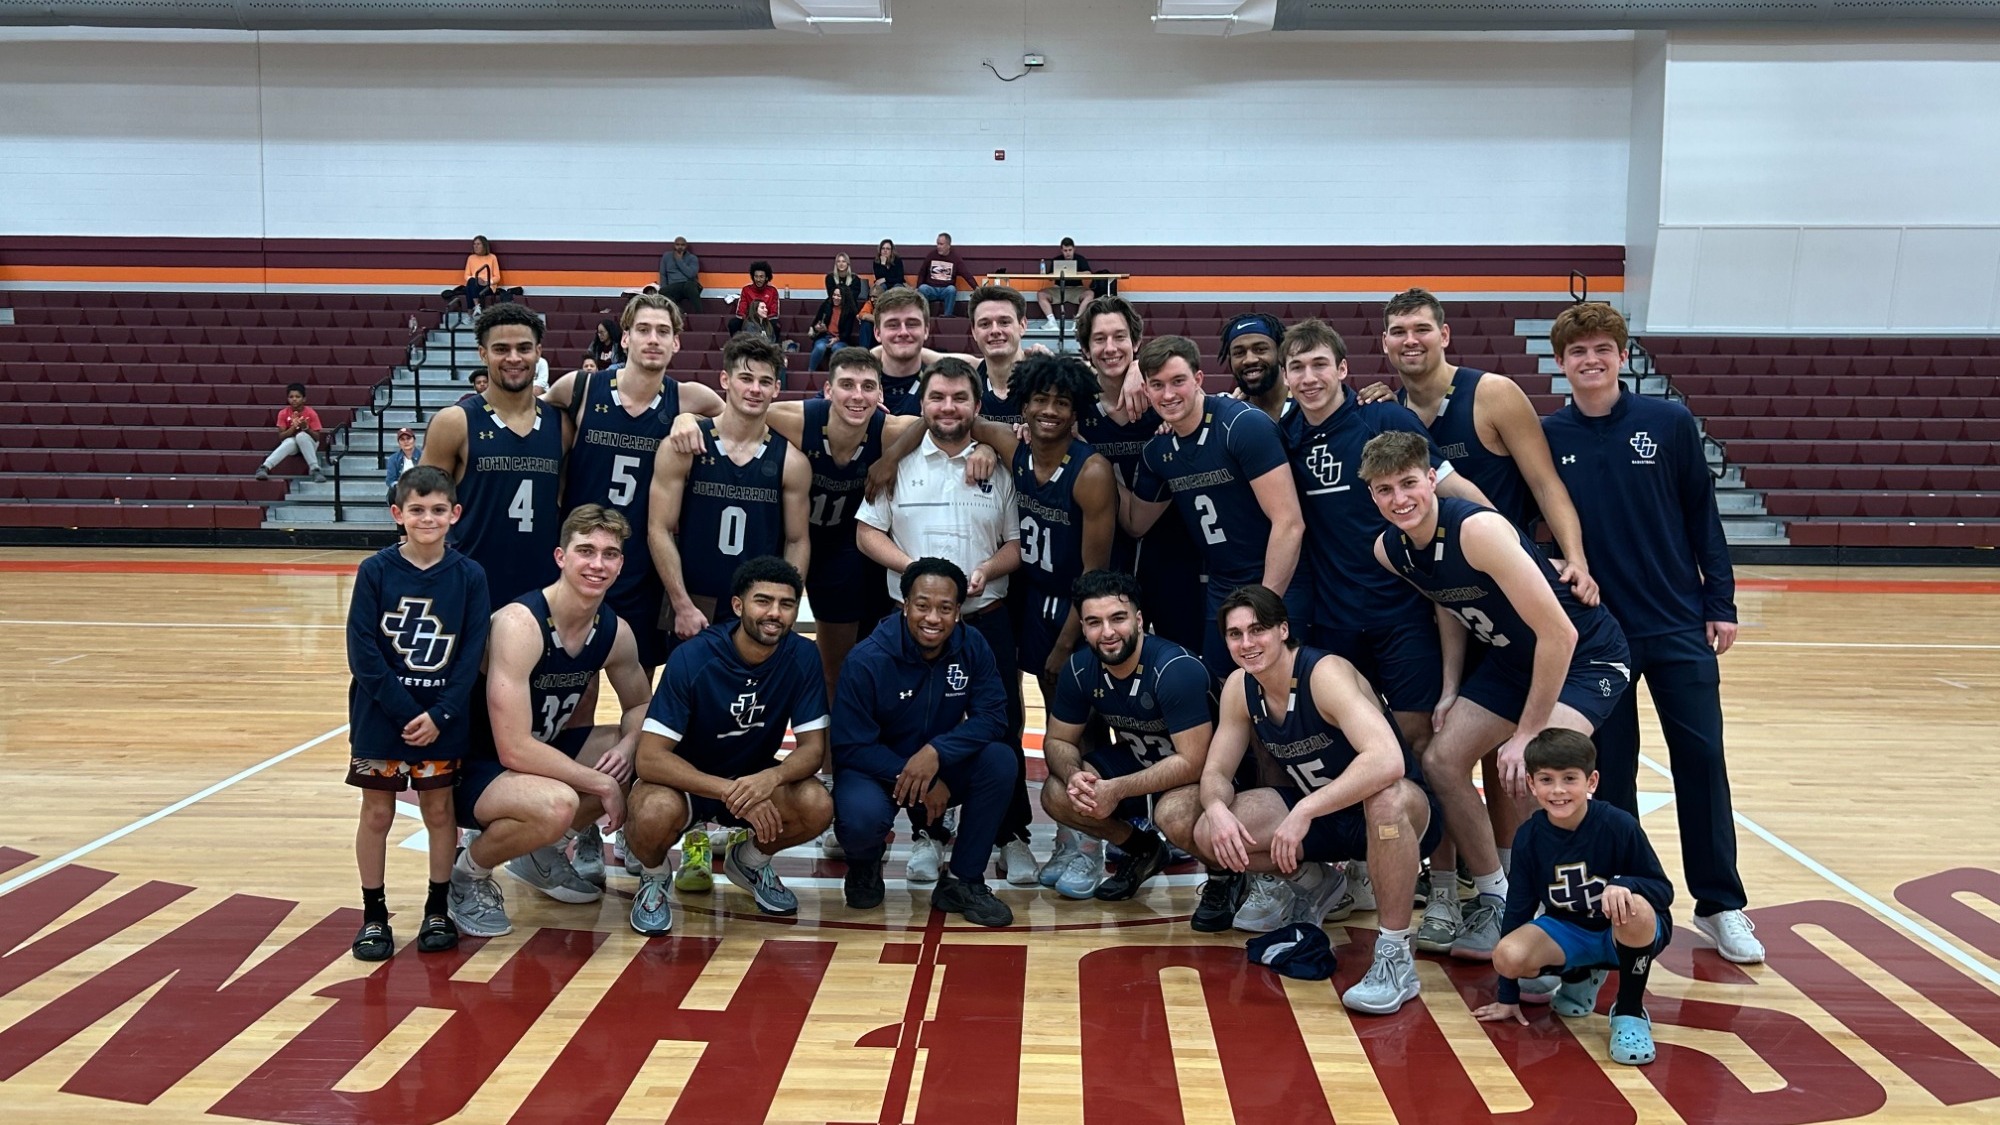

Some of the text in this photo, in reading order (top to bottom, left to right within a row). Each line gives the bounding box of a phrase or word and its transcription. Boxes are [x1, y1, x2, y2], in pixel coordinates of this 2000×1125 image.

[476, 457, 511, 472] JOHN
[585, 429, 663, 452] JOHN CARRO
[1306, 444, 1342, 486] JCU
[1441, 442, 1469, 460] ROLL
[608, 455, 641, 506] 5
[693, 480, 778, 503] JOHN CARROLL
[508, 479, 534, 532] 4
[809, 493, 846, 526] 11
[1194, 494, 1227, 545] 2
[718, 506, 747, 556] 0
[1020, 515, 1053, 573] 31
[380, 597, 456, 672] JCU
[1443, 607, 1511, 647] 2
[531, 693, 581, 742] 32
[1548, 861, 1608, 919] JC
